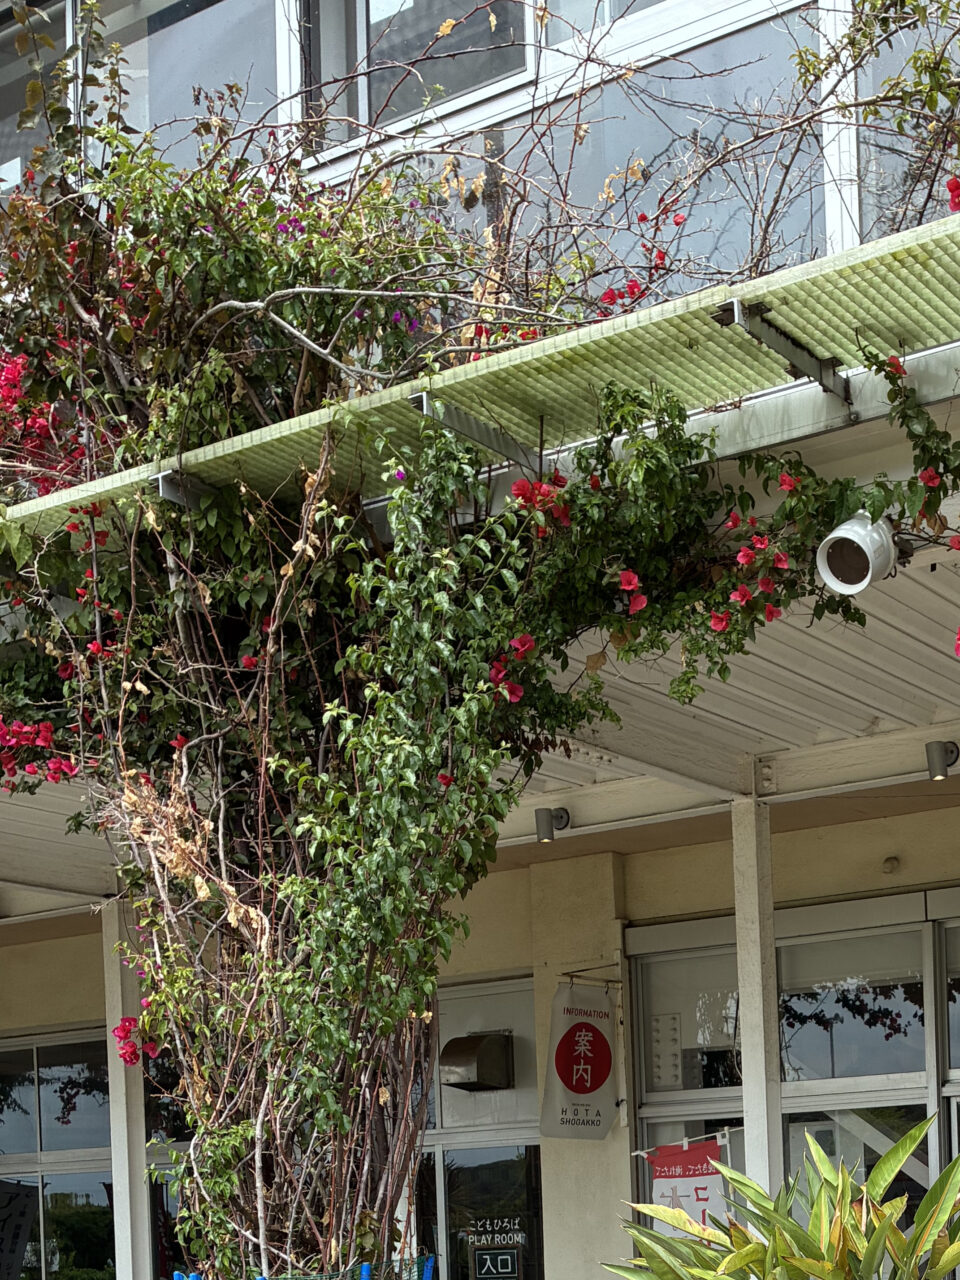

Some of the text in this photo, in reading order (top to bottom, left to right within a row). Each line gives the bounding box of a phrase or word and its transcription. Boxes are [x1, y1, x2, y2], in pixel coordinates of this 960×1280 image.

[563, 1007, 610, 1020] INFORMATION
[573, 1028, 593, 1089] 案内
[560, 1118, 601, 1127] SHOGAKKO
[469, 1217, 521, 1231] こどもひろば
[468, 1233, 522, 1245] PLAY ROOM
[481, 1255, 512, 1274] 入口
